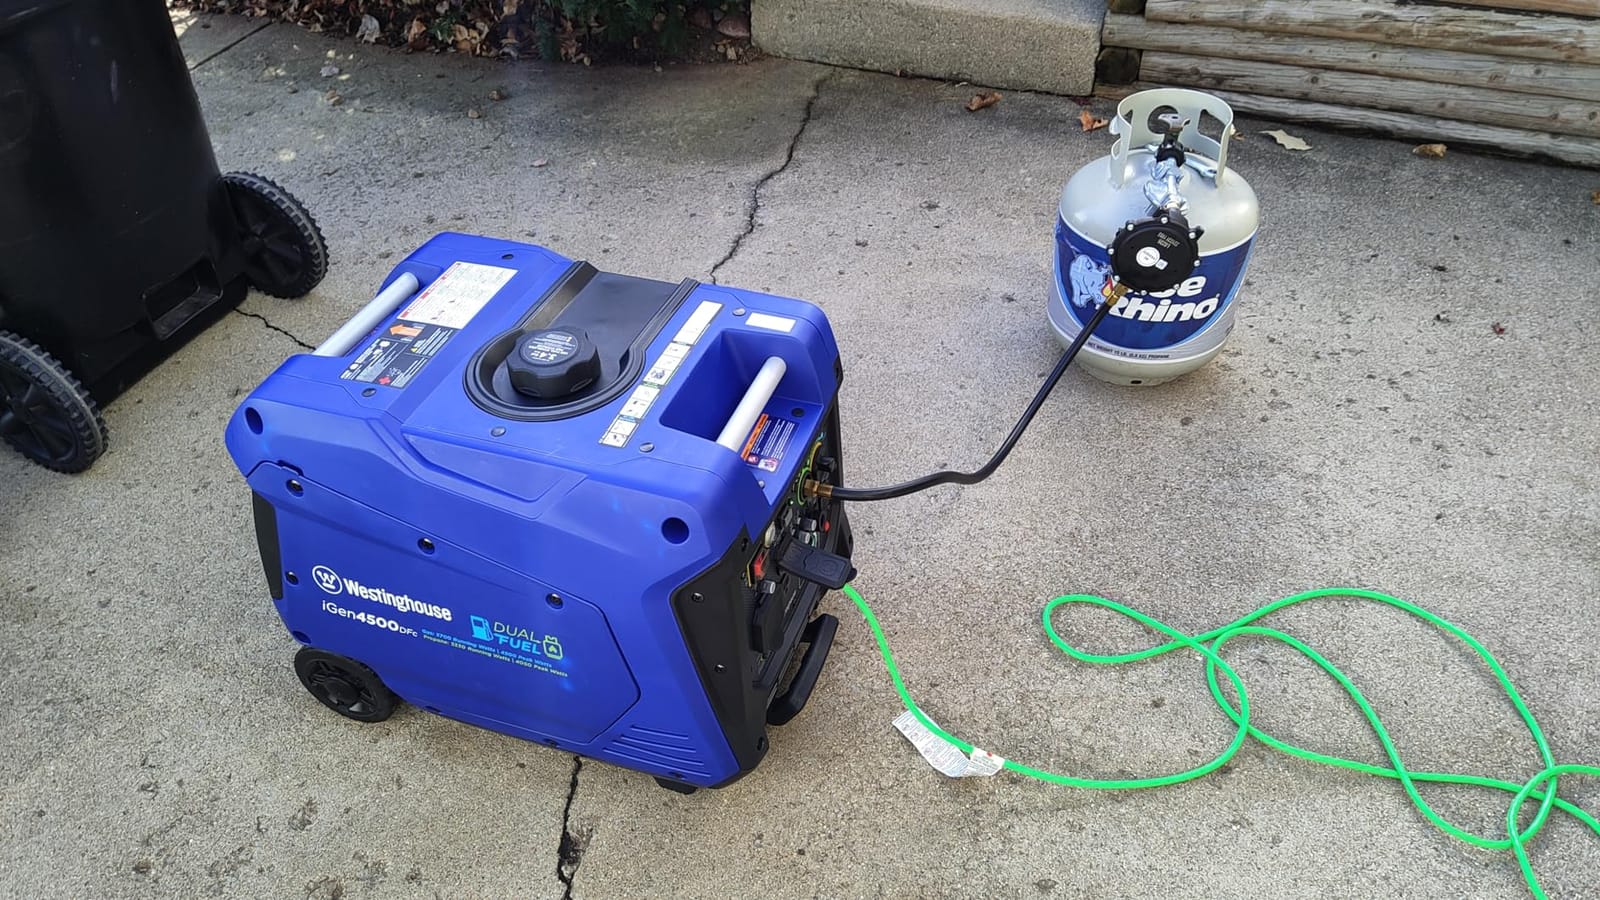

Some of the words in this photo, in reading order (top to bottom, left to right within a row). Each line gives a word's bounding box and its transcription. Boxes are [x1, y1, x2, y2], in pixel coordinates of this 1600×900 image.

[1109, 296, 1218, 322] Rhino
[343, 578, 452, 621] Westinghouse
[494, 622, 541, 643] DUAL
[494, 633, 541, 655] FUEL
[453, 637, 477, 648] Running
[478, 644, 496, 652] Watts
[534, 658, 552, 668] Watts
[467, 646, 492, 657] Running
[493, 653, 510, 662] Watts
[516, 660, 532, 668] 4050
[533, 664, 549, 672] Peak
[549, 668, 568, 677] Watts
